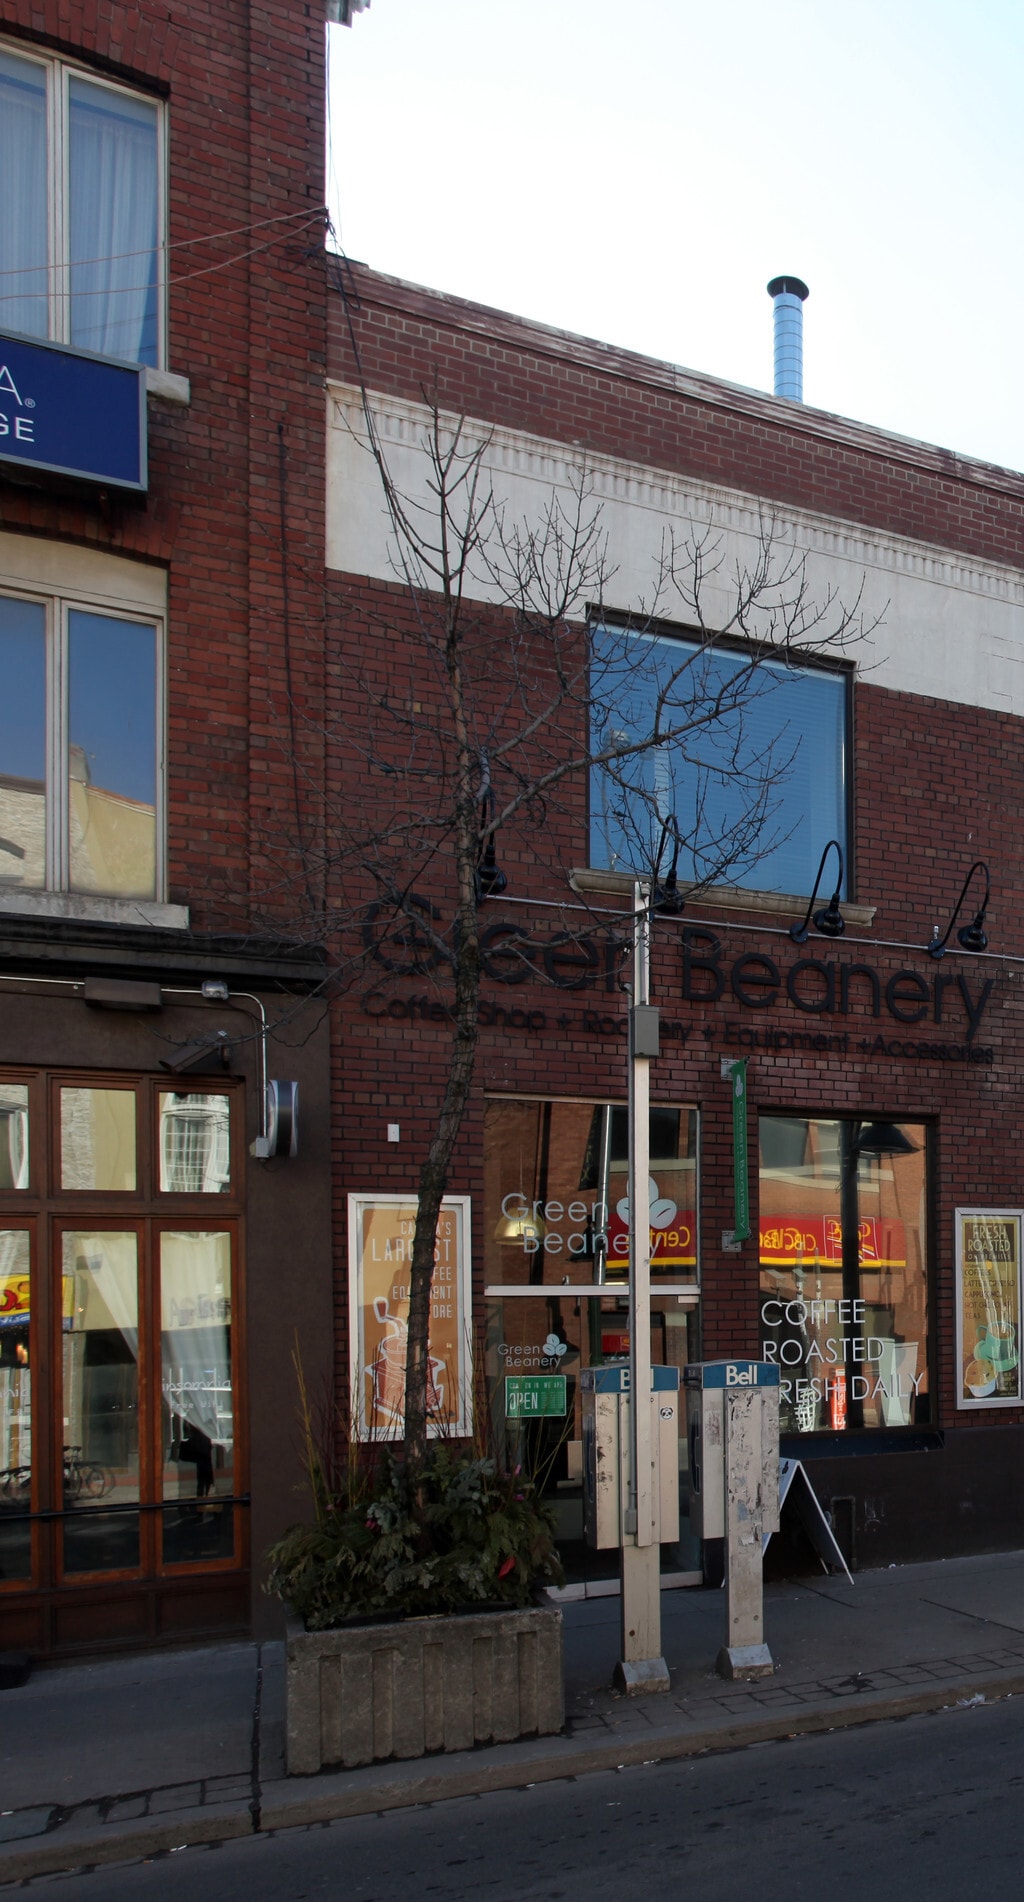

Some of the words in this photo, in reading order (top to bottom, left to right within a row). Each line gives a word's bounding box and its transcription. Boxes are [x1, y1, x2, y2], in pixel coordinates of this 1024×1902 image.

[683, 926, 995, 1041] Beanery
[723, 1022, 849, 1053] Equipment
[501, 1193, 608, 1222] Green
[523, 1226, 662, 1259] Beaney
[967, 1239, 1011, 1252] ROASTED
[973, 1225, 1007, 1239] FRESH
[761, 1299, 866, 1326] COFFEE
[497, 1343, 541, 1356] Green
[505, 1356, 562, 1368] Beanery
[762, 1337, 884, 1366] ROASTED
[726, 1365, 758, 1386] Bell
[779, 1377, 841, 1405] RESH
[852, 1373, 925, 1401] DAILY
[509, 1391, 538, 1410] OPEN
